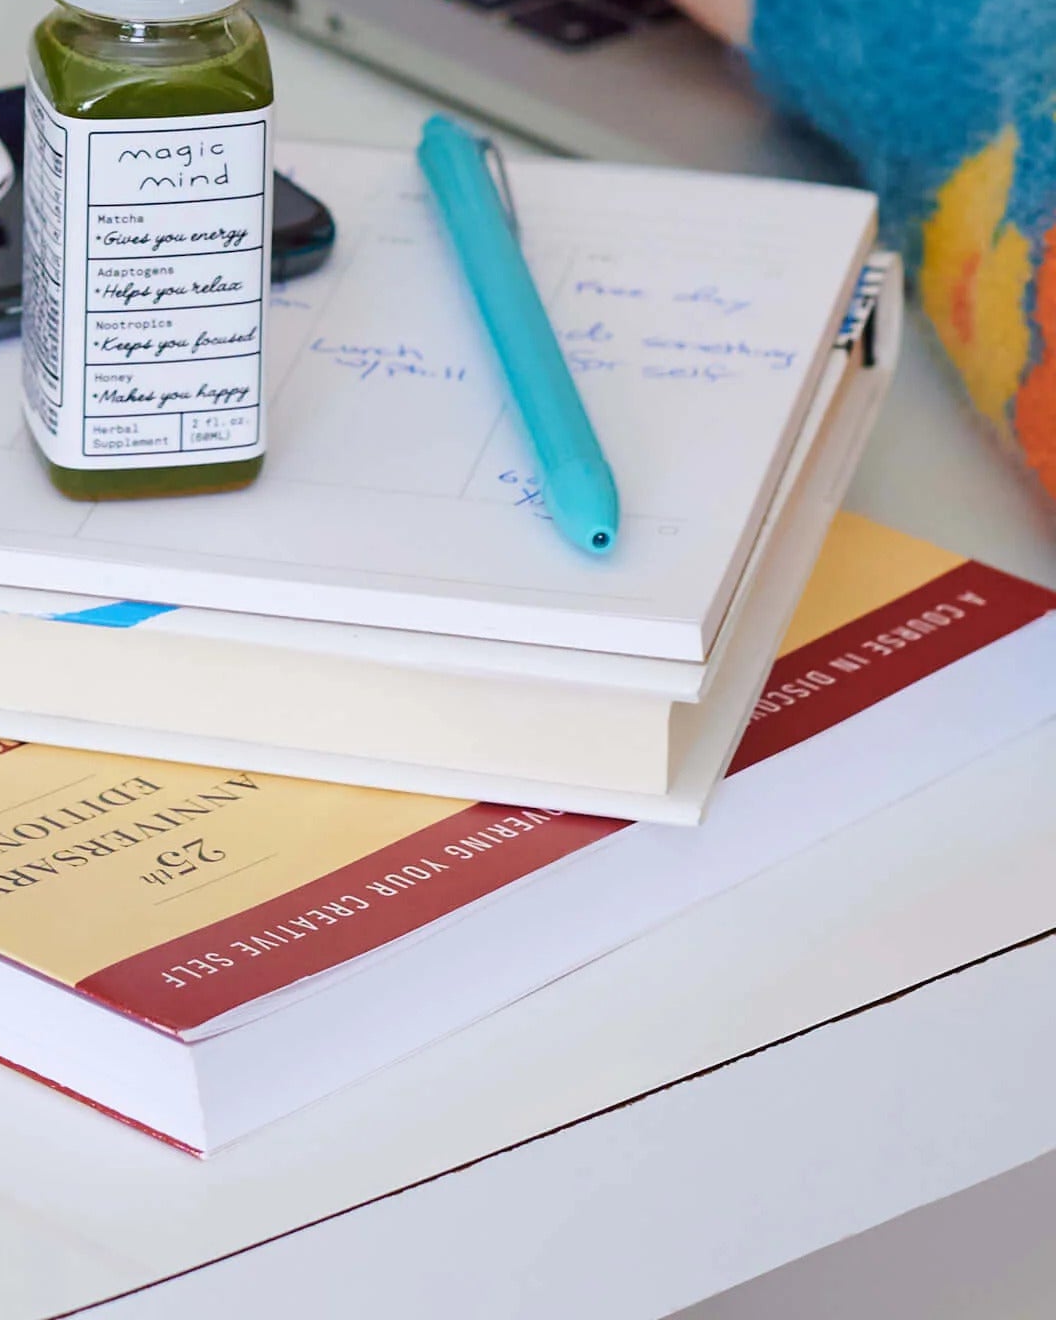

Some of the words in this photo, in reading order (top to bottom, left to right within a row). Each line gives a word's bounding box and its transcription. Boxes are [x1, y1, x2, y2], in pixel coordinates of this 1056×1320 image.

[117, 141, 225, 167] magic
[139, 163, 229, 191] mind
[97, 214, 145, 225] Matcha
[103, 230, 151, 247] Gives
[152, 231, 187, 252] you
[190, 228, 249, 248] energy
[97, 265, 175, 279] Adaptogens
[102, 282, 153, 307] Helps
[153, 286, 188, 305] you
[192, 274, 244, 294] relax
[95, 319, 174, 333] Nootropics
[100, 336, 154, 359] Keeps
[154, 339, 190, 358] you
[191, 326, 259, 355] focused
[94, 372, 134, 384] Honey
[97, 386, 156, 405] Makes
[156, 391, 192, 409] you
[194, 383, 251, 406] happy
[93, 437, 169, 450] Supplement
[956, 590, 988, 606] A
[861, 603, 966, 657] COURSE
[827, 653, 871, 673] IN
[443, 808, 565, 860] VERING
[138, 837, 227, 887] 25th
[364, 857, 450, 899] YOUR
[229, 893, 371, 958] CREATIVE
[160, 951, 235, 989] SELF
